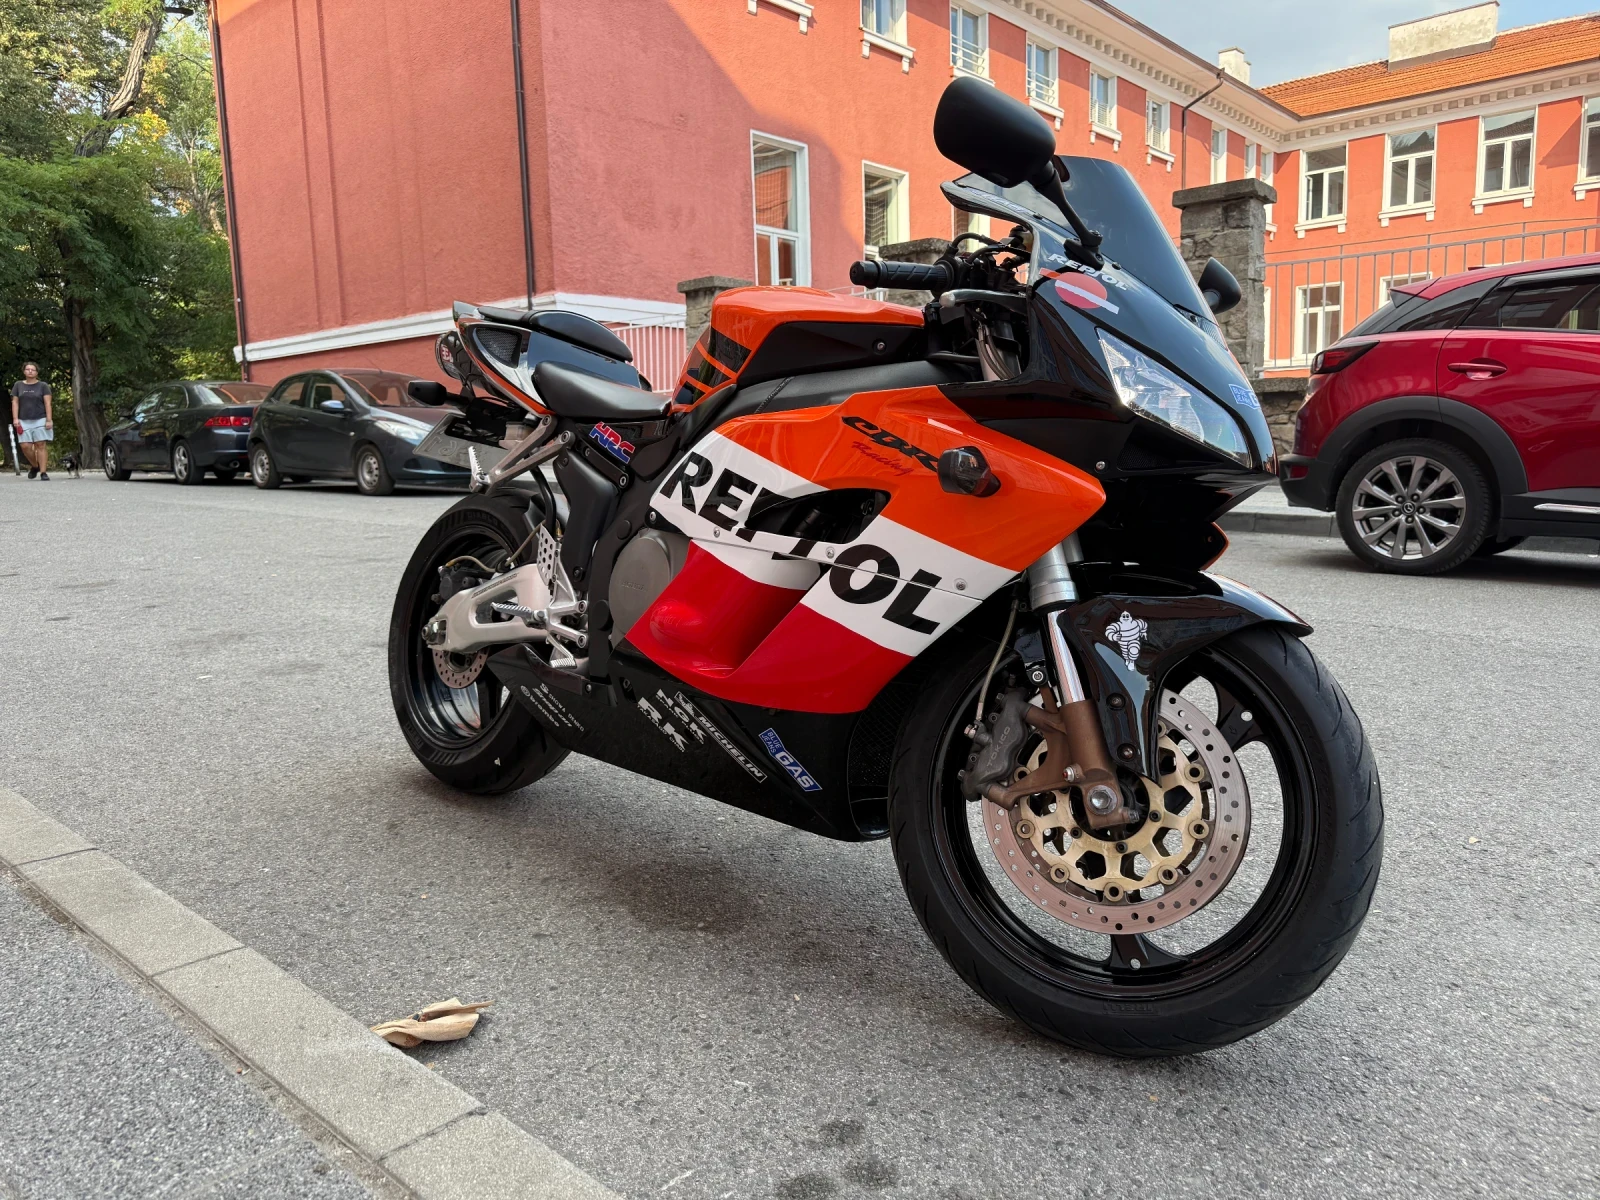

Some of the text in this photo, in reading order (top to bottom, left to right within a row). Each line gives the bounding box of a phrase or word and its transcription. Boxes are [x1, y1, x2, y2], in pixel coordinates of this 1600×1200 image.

[589, 421, 636, 464] HRC
[852, 441, 915, 476] Racing
[548, 693, 585, 732] SHOWA DENKO
[638, 696, 690, 751] RK
[656, 688, 707, 742] NGK
[699, 716, 763, 777] MICHELIN
[761, 734, 777, 754] JEANS
[767, 731, 781, 749] BLUE
[986, 726, 1011, 767] TOKICO
[775, 751, 814, 788] GAS
